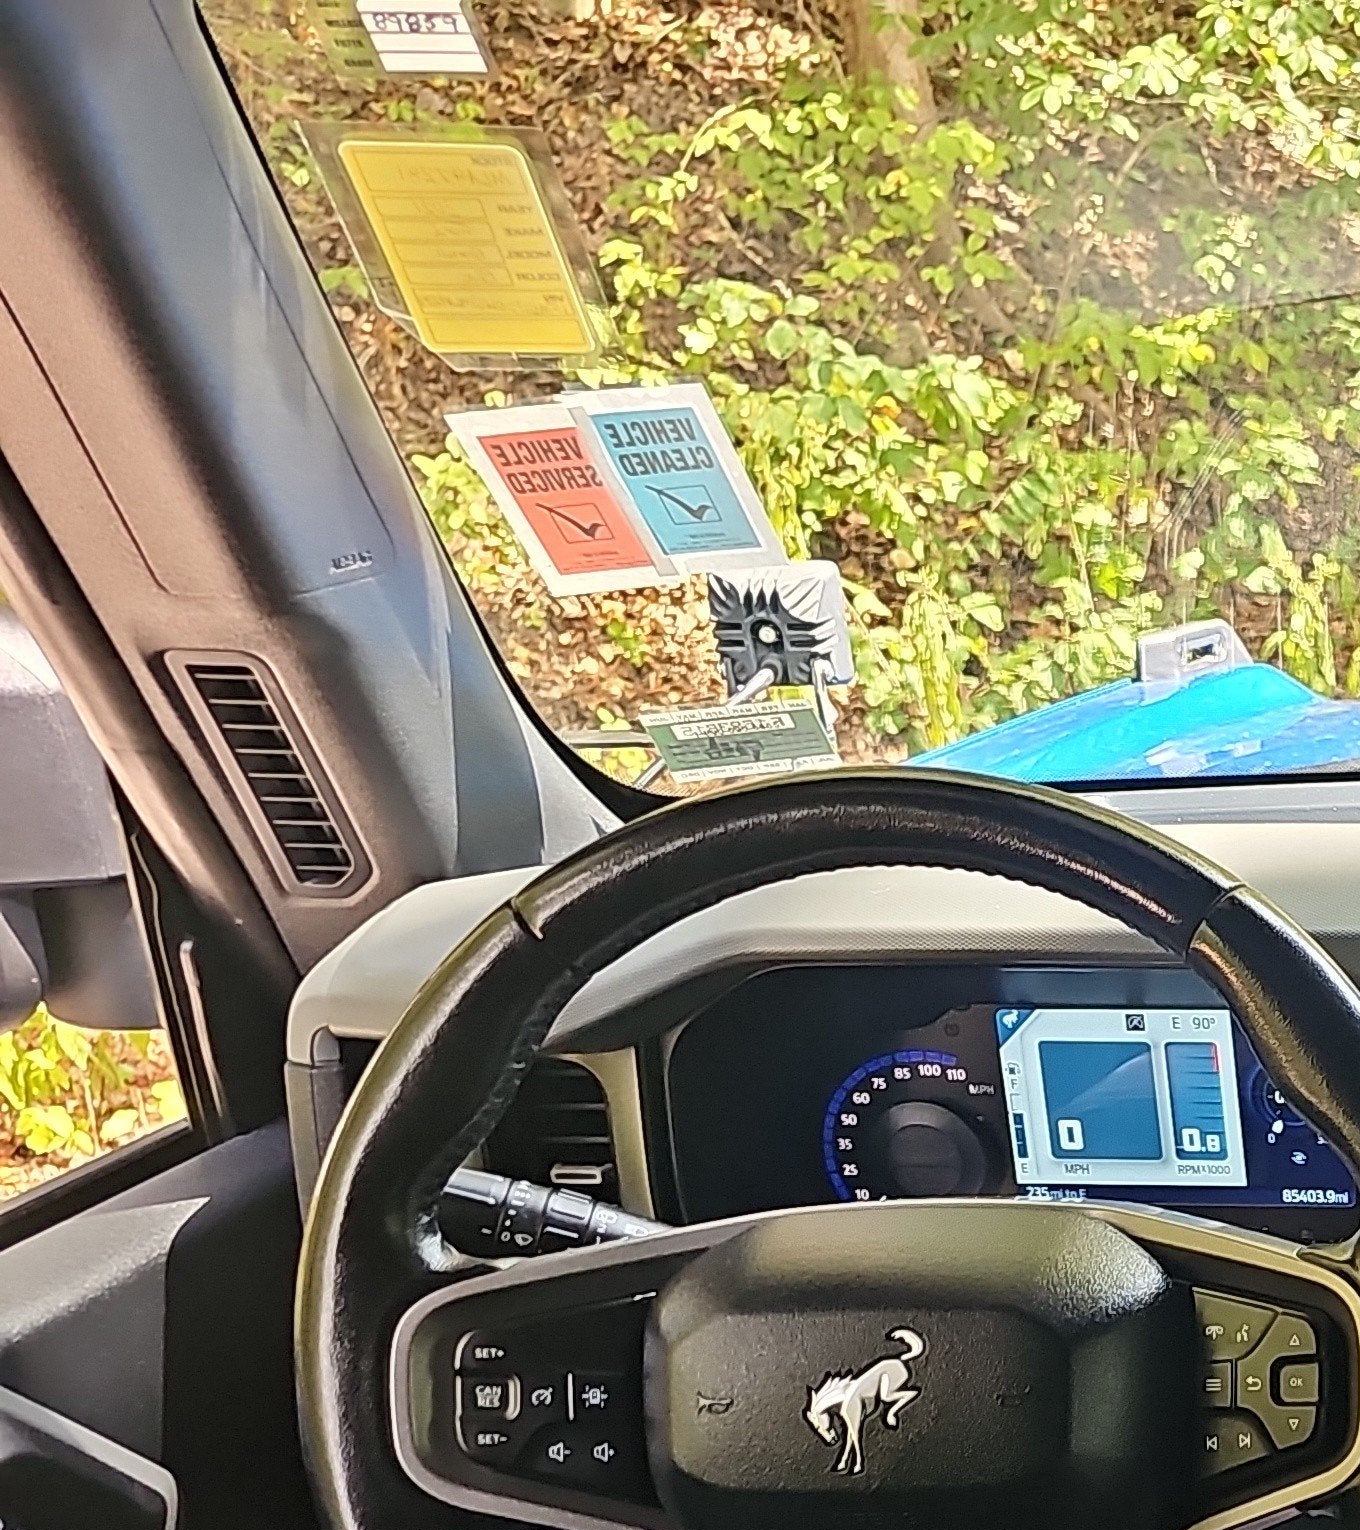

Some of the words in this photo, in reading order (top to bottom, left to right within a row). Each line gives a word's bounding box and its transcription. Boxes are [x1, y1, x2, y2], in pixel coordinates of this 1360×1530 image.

[1172, 1017, 1181, 1029] E
[1192, 1016, 1216, 1030] 90°
[893, 1067, 911, 1080] 85
[918, 1064, 942, 1077] 100
[945, 1068, 967, 1081] 110
[871, 1077, 887, 1090] 75
[968, 1084, 995, 1095] MPH
[852, 1092, 871, 1105] 60
[840, 1113, 858, 1126] 50
[1057, 1119, 1085, 1151] 0
[1181, 1127, 1221, 1153] 0.8
[837, 1138, 853, 1151] 35
[841, 1163, 859, 1176] 25
[1020, 1162, 1029, 1174] E
[1064, 1163, 1090, 1175] MPH
[854, 1188, 870, 1200] 10
[1282, 1188, 1349, 1204] 85403.9mi
[474, 1347, 505, 1359] SET+
[1289, 1377, 1304, 1387] OK
